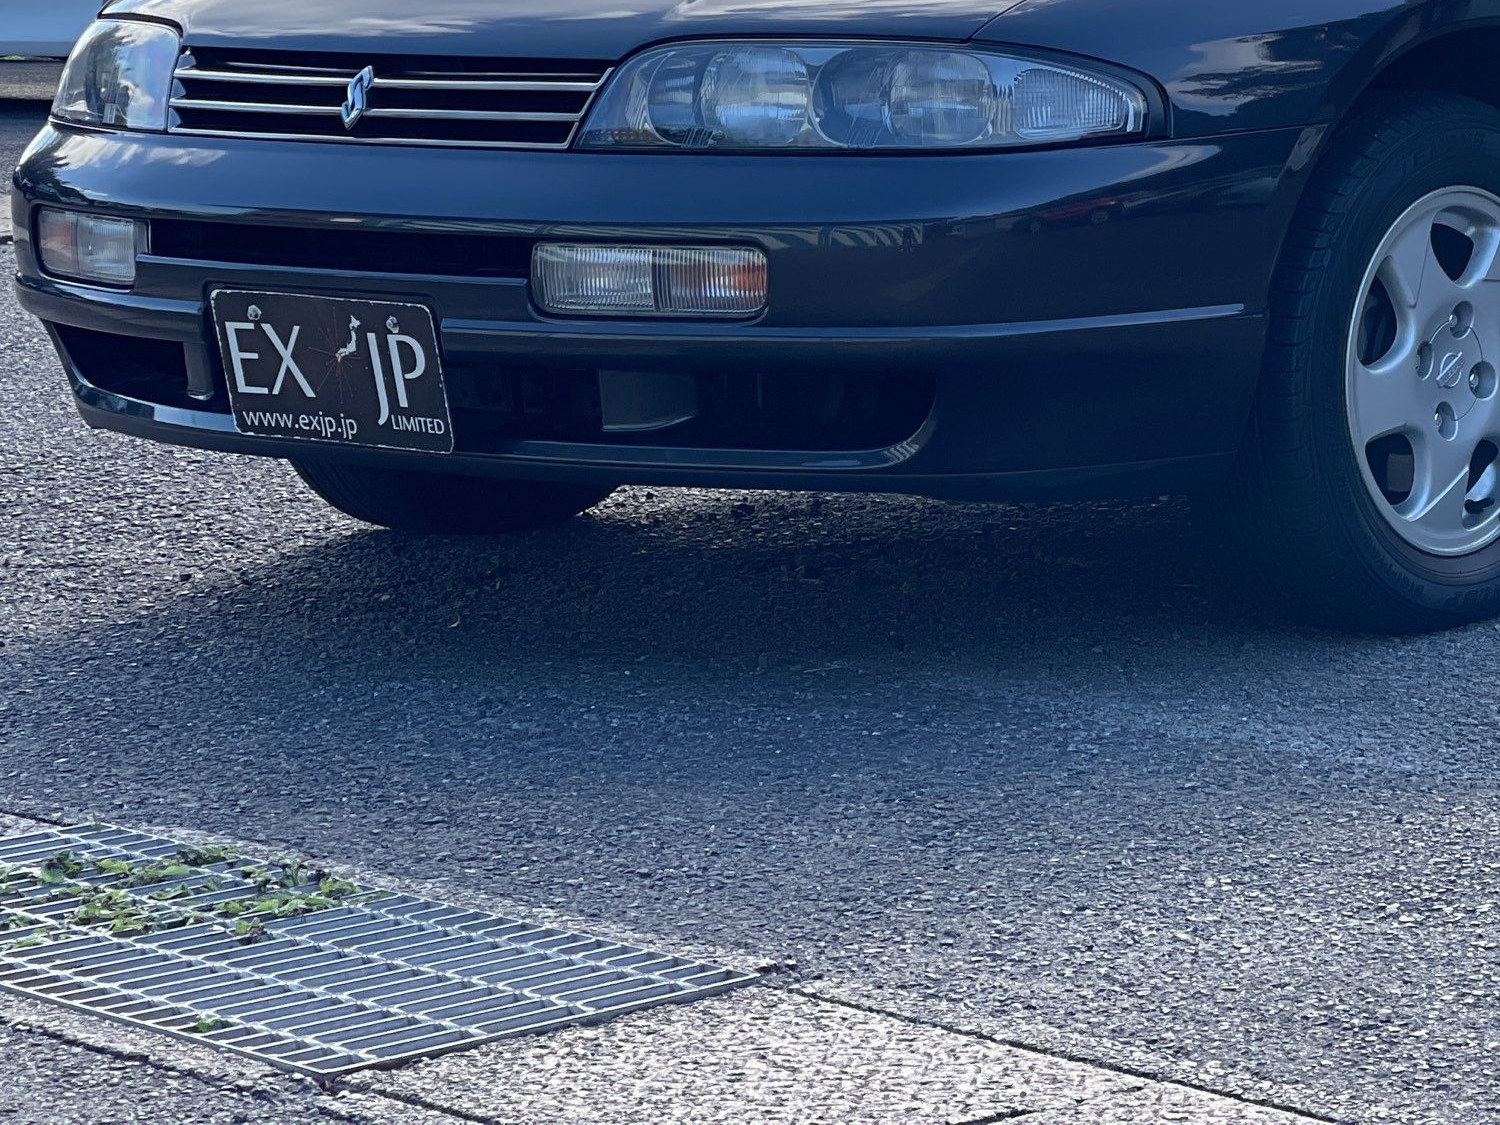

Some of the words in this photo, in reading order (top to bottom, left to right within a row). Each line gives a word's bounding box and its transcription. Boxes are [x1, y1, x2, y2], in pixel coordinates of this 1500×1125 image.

[224, 321, 317, 398] EX
[366, 331, 427, 426] JP
[243, 410, 358, 440] www.exjp.jp
[391, 414, 446, 435] LIMITED
